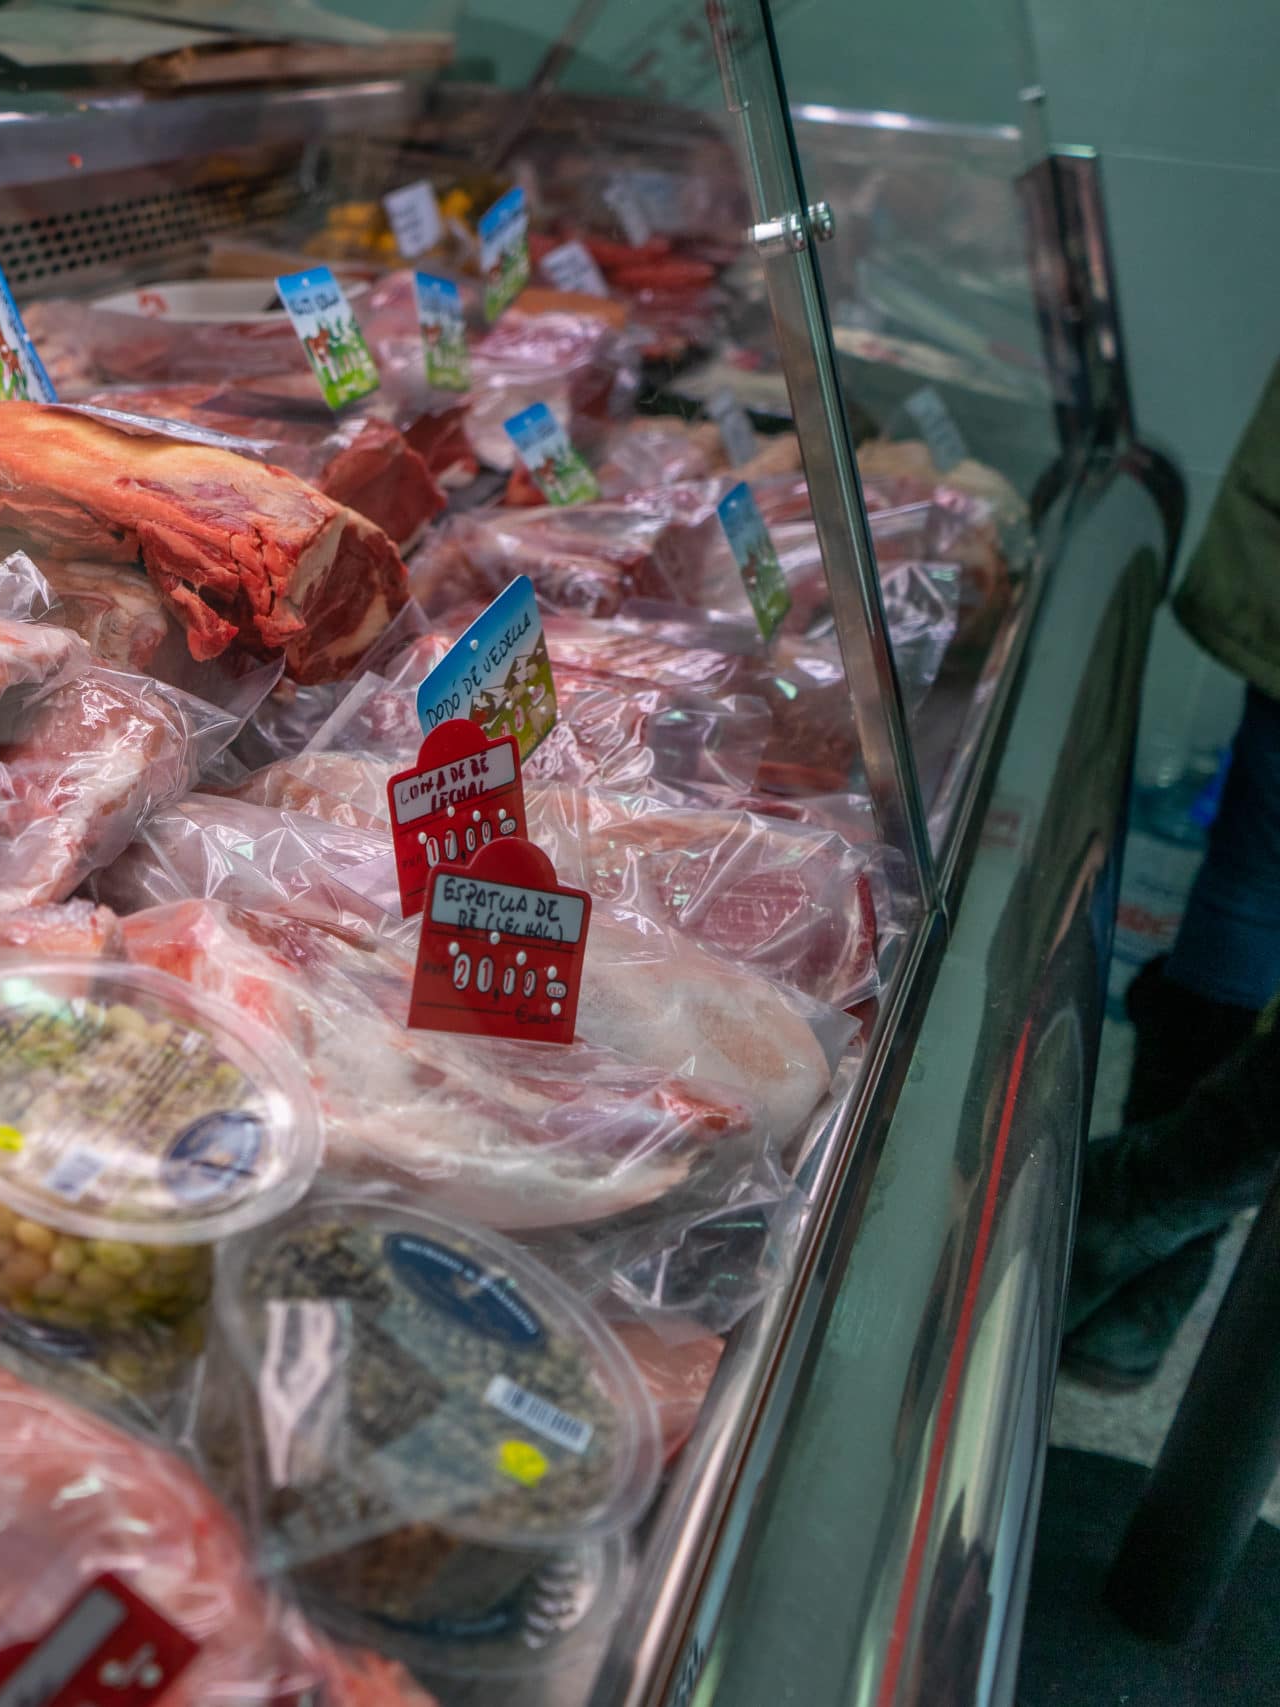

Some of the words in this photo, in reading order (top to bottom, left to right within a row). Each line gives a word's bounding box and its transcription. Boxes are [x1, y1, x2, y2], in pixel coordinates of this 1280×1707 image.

[462, 666, 484, 699] DE
[450, 761, 467, 783] DE
[535, 898, 561, 922] DE
